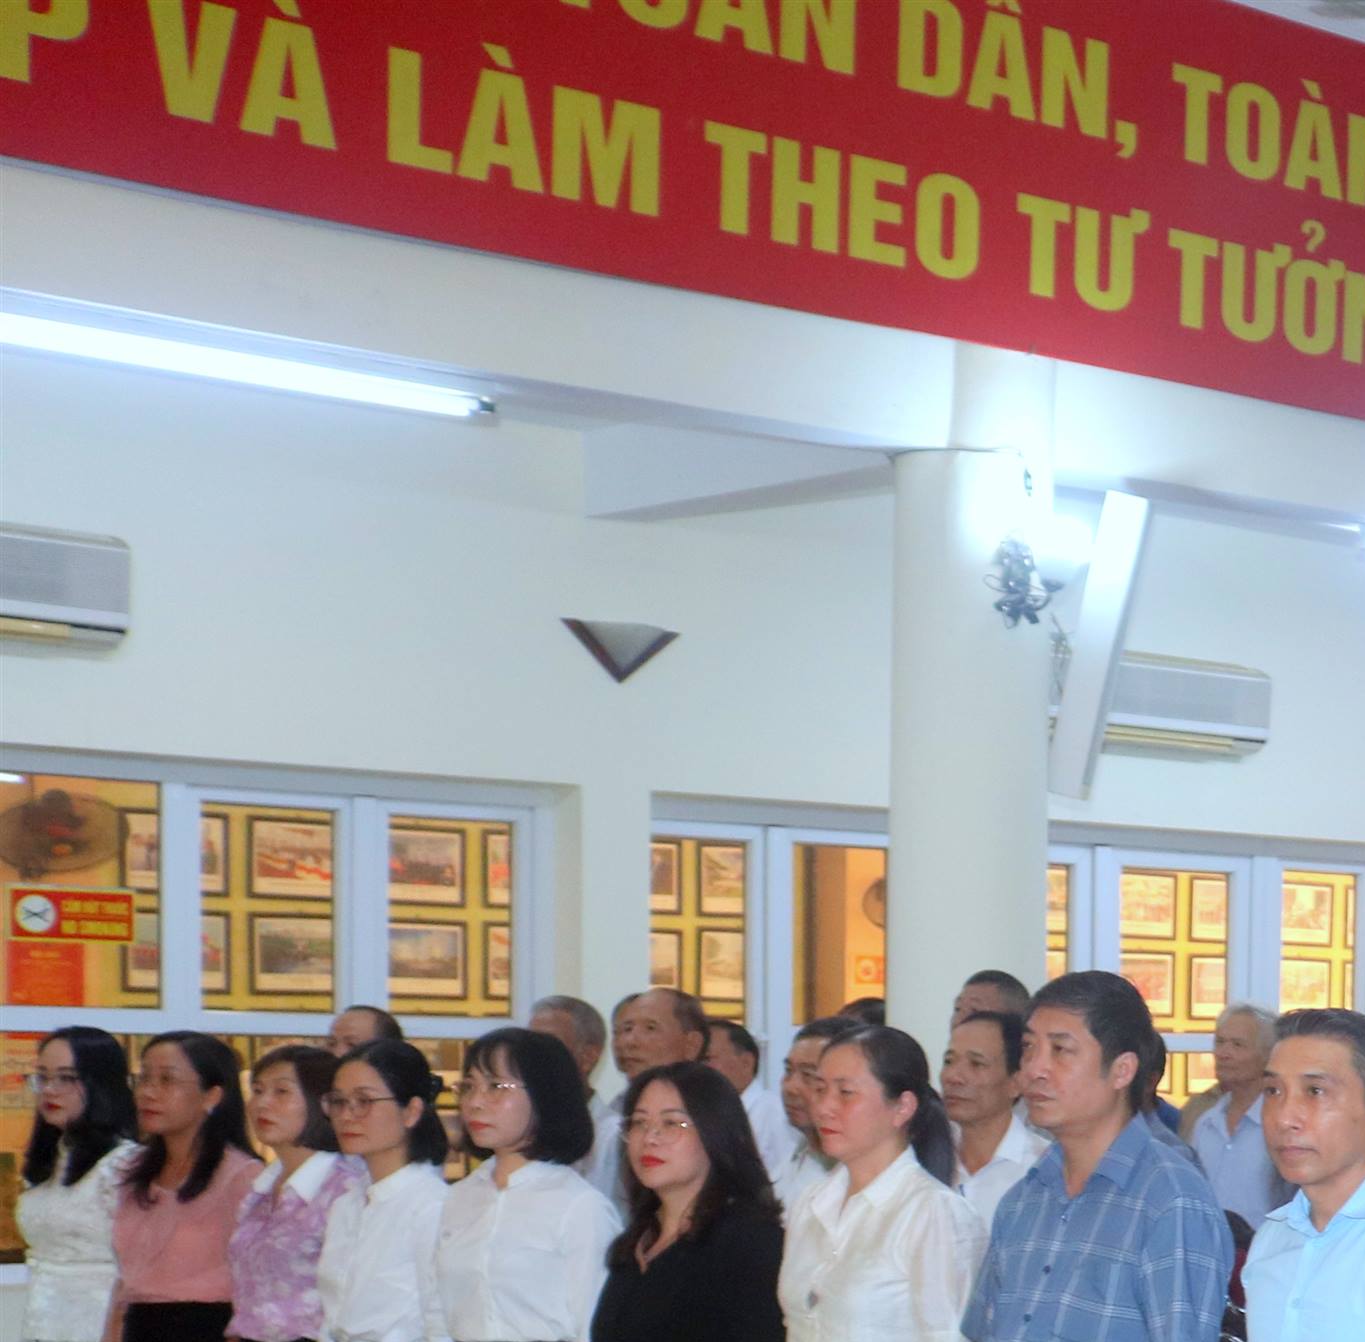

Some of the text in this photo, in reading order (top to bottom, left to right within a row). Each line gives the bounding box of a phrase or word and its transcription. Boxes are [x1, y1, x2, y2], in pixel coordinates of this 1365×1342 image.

[147, 0, 338, 151] VÀ
[387, 42, 662, 217] LÀM
[704, 119, 981, 281] THEO
[1016, 191, 1151, 312] TƯ
